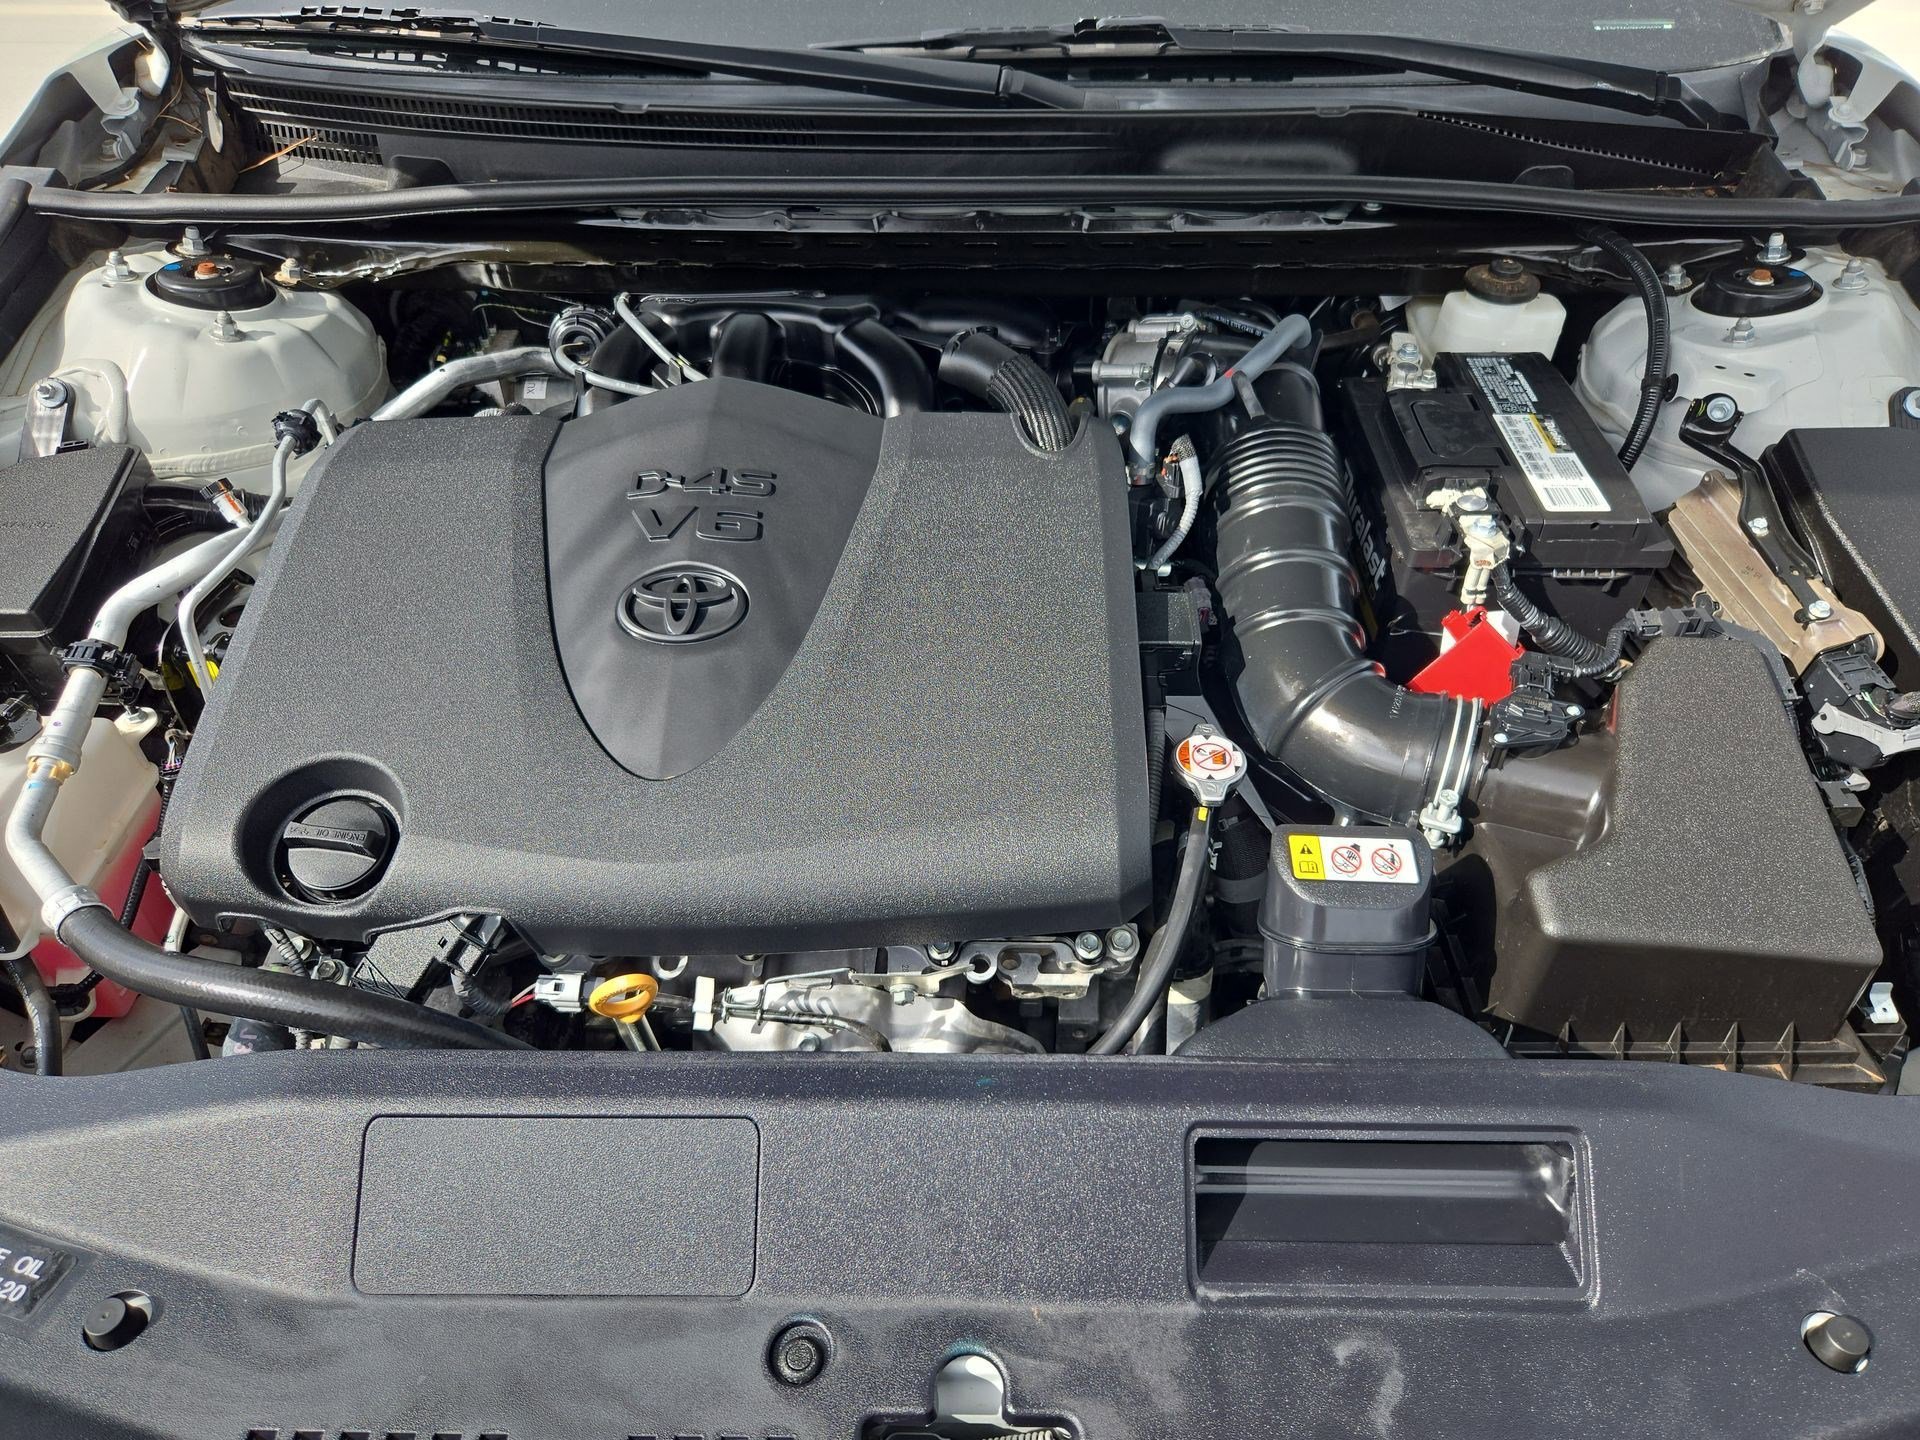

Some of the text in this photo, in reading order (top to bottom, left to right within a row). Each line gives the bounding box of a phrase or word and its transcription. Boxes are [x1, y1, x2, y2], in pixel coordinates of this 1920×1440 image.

[627, 467, 777, 499] D-4S
[632, 506, 763, 542] V6
[13, 1256, 44, 1279] OIL
[0, 1281, 27, 1302] 20
